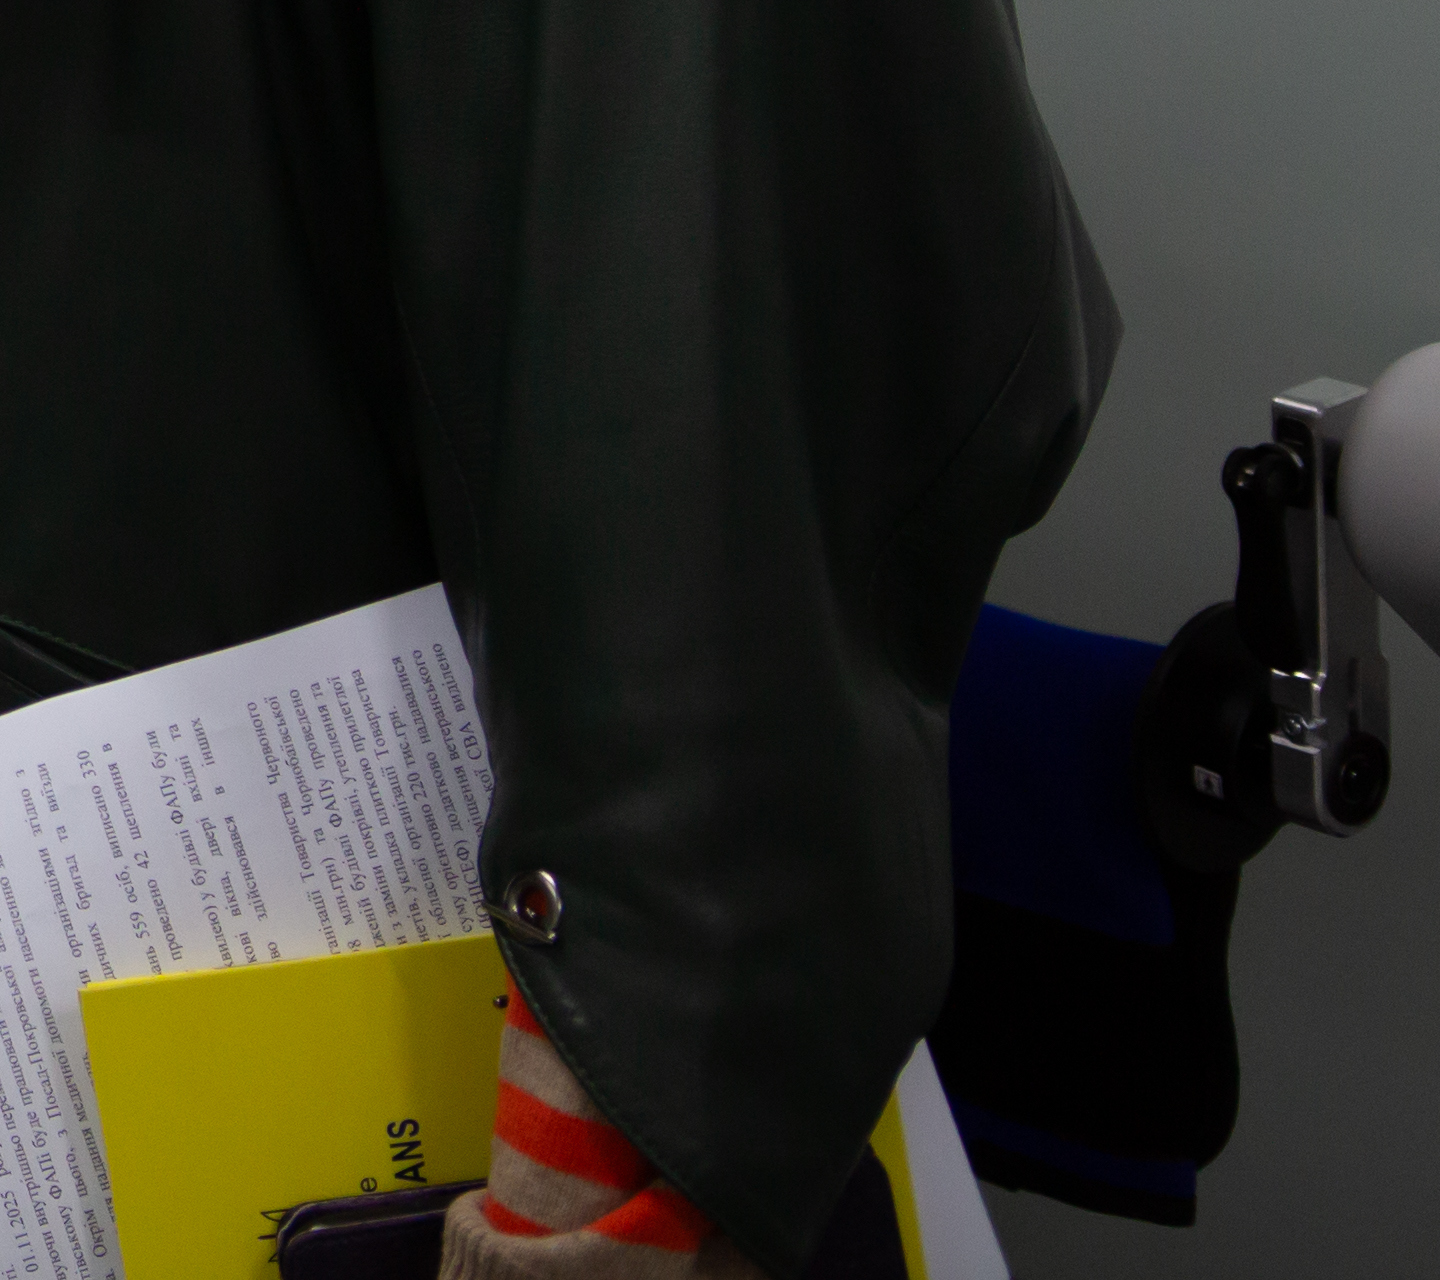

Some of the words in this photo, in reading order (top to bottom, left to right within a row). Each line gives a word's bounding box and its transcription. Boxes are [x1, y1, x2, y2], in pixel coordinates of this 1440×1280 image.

[310, 681, 324, 701] та
[391, 655, 432, 745] надавалися
[412, 649, 461, 762] ветеранського
[431, 642, 467, 713] виділено
[168, 723, 182, 742] та
[190, 717, 216, 768] інших
[289, 689, 326, 771] проведено
[326, 675, 367, 754] прилеглої
[351, 668, 390, 761] Товариства
[388, 705, 417, 769] тис.грн.
[458, 721, 483, 761] СВА
[76, 750, 97, 779] 330
[102, 742, 113, 753] в
[145, 730, 168, 769] були
[246, 701, 281, 786] Червоного
[263, 695, 315, 817] Чорнобаївської
[317, 704, 358, 785] утеплення
[15, 769, 25, 778] з
[37, 762, 60, 813] виїзди
[107, 762, 143, 841] щеплення
[159, 775, 184, 825] ФАПу
[174, 755, 203, 803] вхідні
[214, 785, 226, 796] в
[359, 757, 391, 827] плиткою
[406, 771, 429, 802] 220
[425, 751, 464, 832] додатково
[473, 767, 491, 793] кої
[21, 788, 43, 837] згідно
[91, 785, 124, 859] виписано
[317, 778, 343, 829] ФАПу
[343, 788, 379, 860] покрівлі,
[380, 765, 423, 851] організації
[453, 765, 492, 841] міщення
[56, 825, 69, 843] та
[133, 850, 150, 870] 42
[174, 829, 208, 887] будівлі
[195, 816, 224, 857] двері
[277, 791, 316, 884] Товариства
[313, 827, 327, 846] та
[383, 830, 419, 895] укладка
[420, 803, 460, 891] орієнтовно
[65, 854, 93, 911] бригад
[114, 865, 138, 904] осіб,
[223, 815, 268, 922] здійснювався
[319, 857, 355, 926] млн.грн)
[334, 834, 367, 892] будівлі
[371, 864, 399, 918] заміни
[411, 857, 448, 926] обласної
[0, 876, 35, 963] населенню
[38, 847, 84, 959] організаціями
[147, 878, 184, 961] проведено
[200, 892, 216, 901] у
[220, 870, 243, 917] вікна,
[451, 895, 475, 933] суму
[129, 911, 151, 939] 559
[267, 941, 281, 960] во
[391, 921, 403, 931] з
[145, 945, 163, 974] ань
[28, 967, 64, 1044] допомоги
[2, 964, 62, 1120] Посад-Покровської
[51, 1049, 89, 1123] медичної
[26, 1111, 48, 1149] буде
[57, 1128, 69, 1138] з
[10, 1134, 50, 1227] внутрішньо
[36, 1152, 63, 1200] ФАПі
[65, 1147, 89, 1198] цього,
[81, 1126, 110, 1192] надання
[0, 1190, 40, 1273] 01.11.2025
[83, 1208, 108, 1259] Окрім
